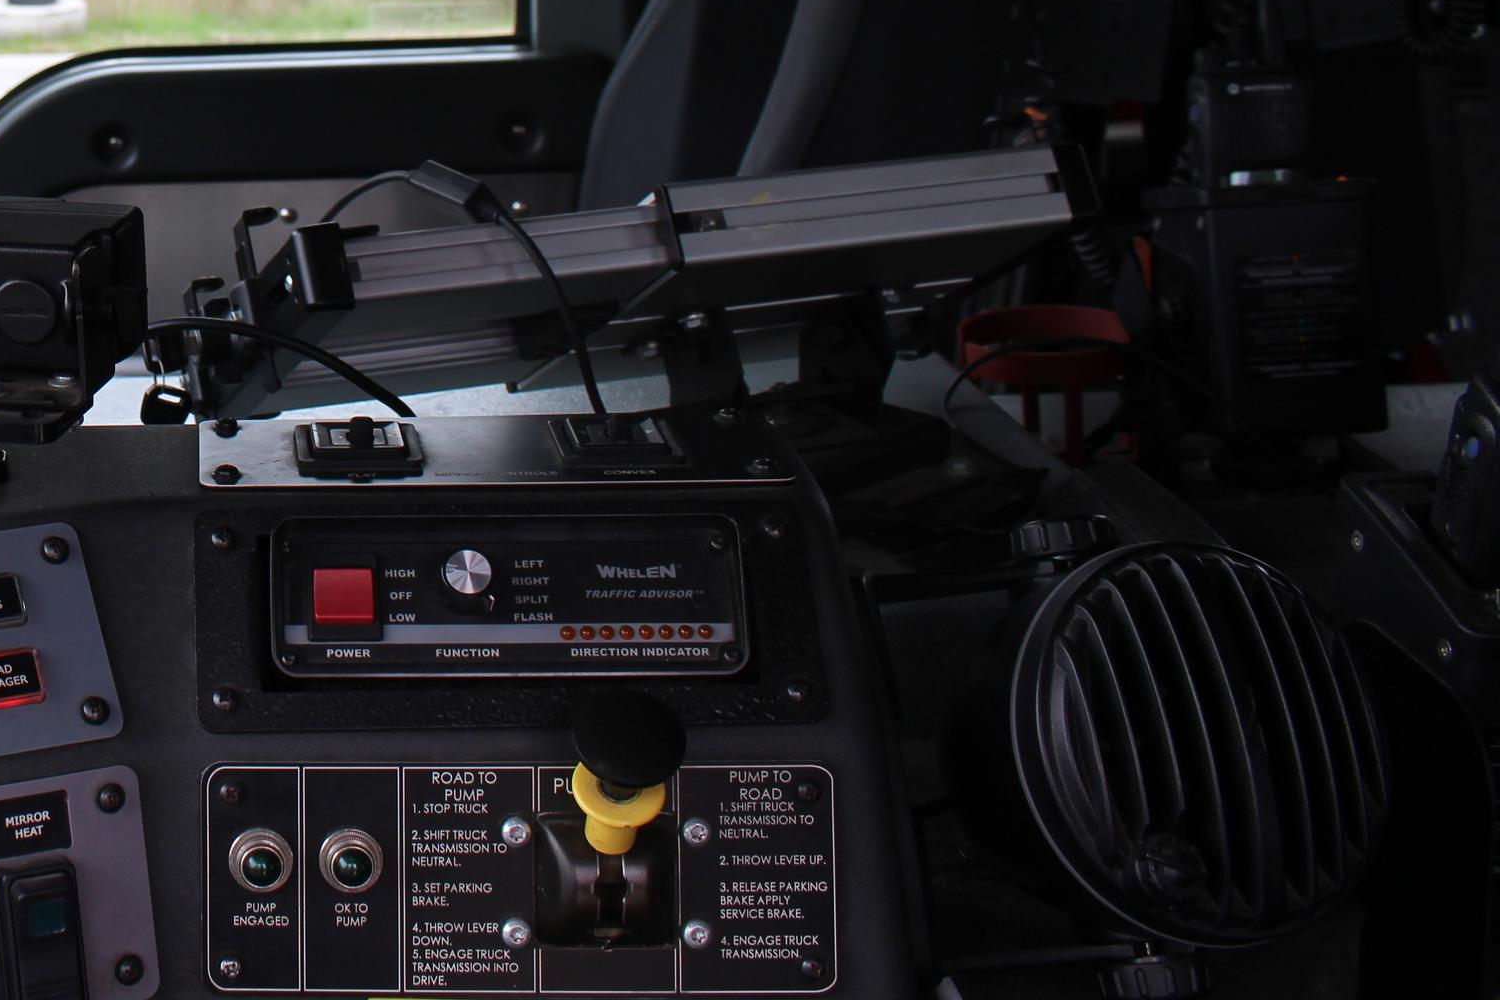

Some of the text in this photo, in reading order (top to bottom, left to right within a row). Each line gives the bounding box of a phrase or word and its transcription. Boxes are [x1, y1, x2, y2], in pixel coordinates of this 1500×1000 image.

[515, 560, 543, 568] LEFT
[385, 570, 415, 578] HIGH
[512, 577, 550, 585] RIGHT
[390, 591, 412, 600] OFF
[515, 595, 550, 603] SPLIT
[585, 590, 694, 598] TRAFFIC ADVISOR
[389, 613, 416, 621] LOW
[514, 613, 553, 621] FLASH
[327, 649, 370, 658] POWER
[435, 649, 500, 657] FUNCTION
[570, 648, 709, 656] DIRECTION INDICATOR
[432, 772, 497, 785] ROAD TO
[729, 770, 791, 783] PUMP TO
[444, 789, 484, 801] PUMP
[739, 788, 782, 800] ROAD
[412, 804, 487, 813] 1. STOP TRUCK
[720, 801, 794, 811] 1. SHIFT TRUCK
[5, 811, 51, 826] MIRROR
[719, 815, 814, 825] TRANSMISSION TO
[15, 825, 44, 839] HEAT
[412, 830, 487, 840] 2. SHIFT TRUCK
[719, 828, 768, 839] NEUTRAL.
[412, 843, 507, 853] TRANSMISSION TO
[412, 856, 461, 866] NEUTRAL.
[719, 854, 826, 865] 2. THROW LEVER UP.
[412, 882, 492, 893] 3. SET PARKING
[719, 881, 828, 892] 3. RELEASE PARKING
[412, 896, 449, 906] BRAKE.
[720, 895, 790, 905] BRAKE APPLY
[246, 903, 276, 912] PUMP
[335, 903, 368, 913] OK TO
[720, 908, 804, 919] SERVICE BRAKE.
[233, 915, 289, 926] ENGAGED
[336, 916, 366, 926] PUMP
[412, 922, 498, 933] 4. THROW LEVER
[412, 935, 452, 946] DOWN.
[720, 934, 818, 945] 4. ENGAGE TRUCK
[412, 949, 510, 959] 5. ENGAGE TRUCK
[720, 949, 801, 959] TRANSMISSION.
[412, 962, 519, 973] TRANSMISSION INTO
[412, 975, 447, 986] DRIVE.
